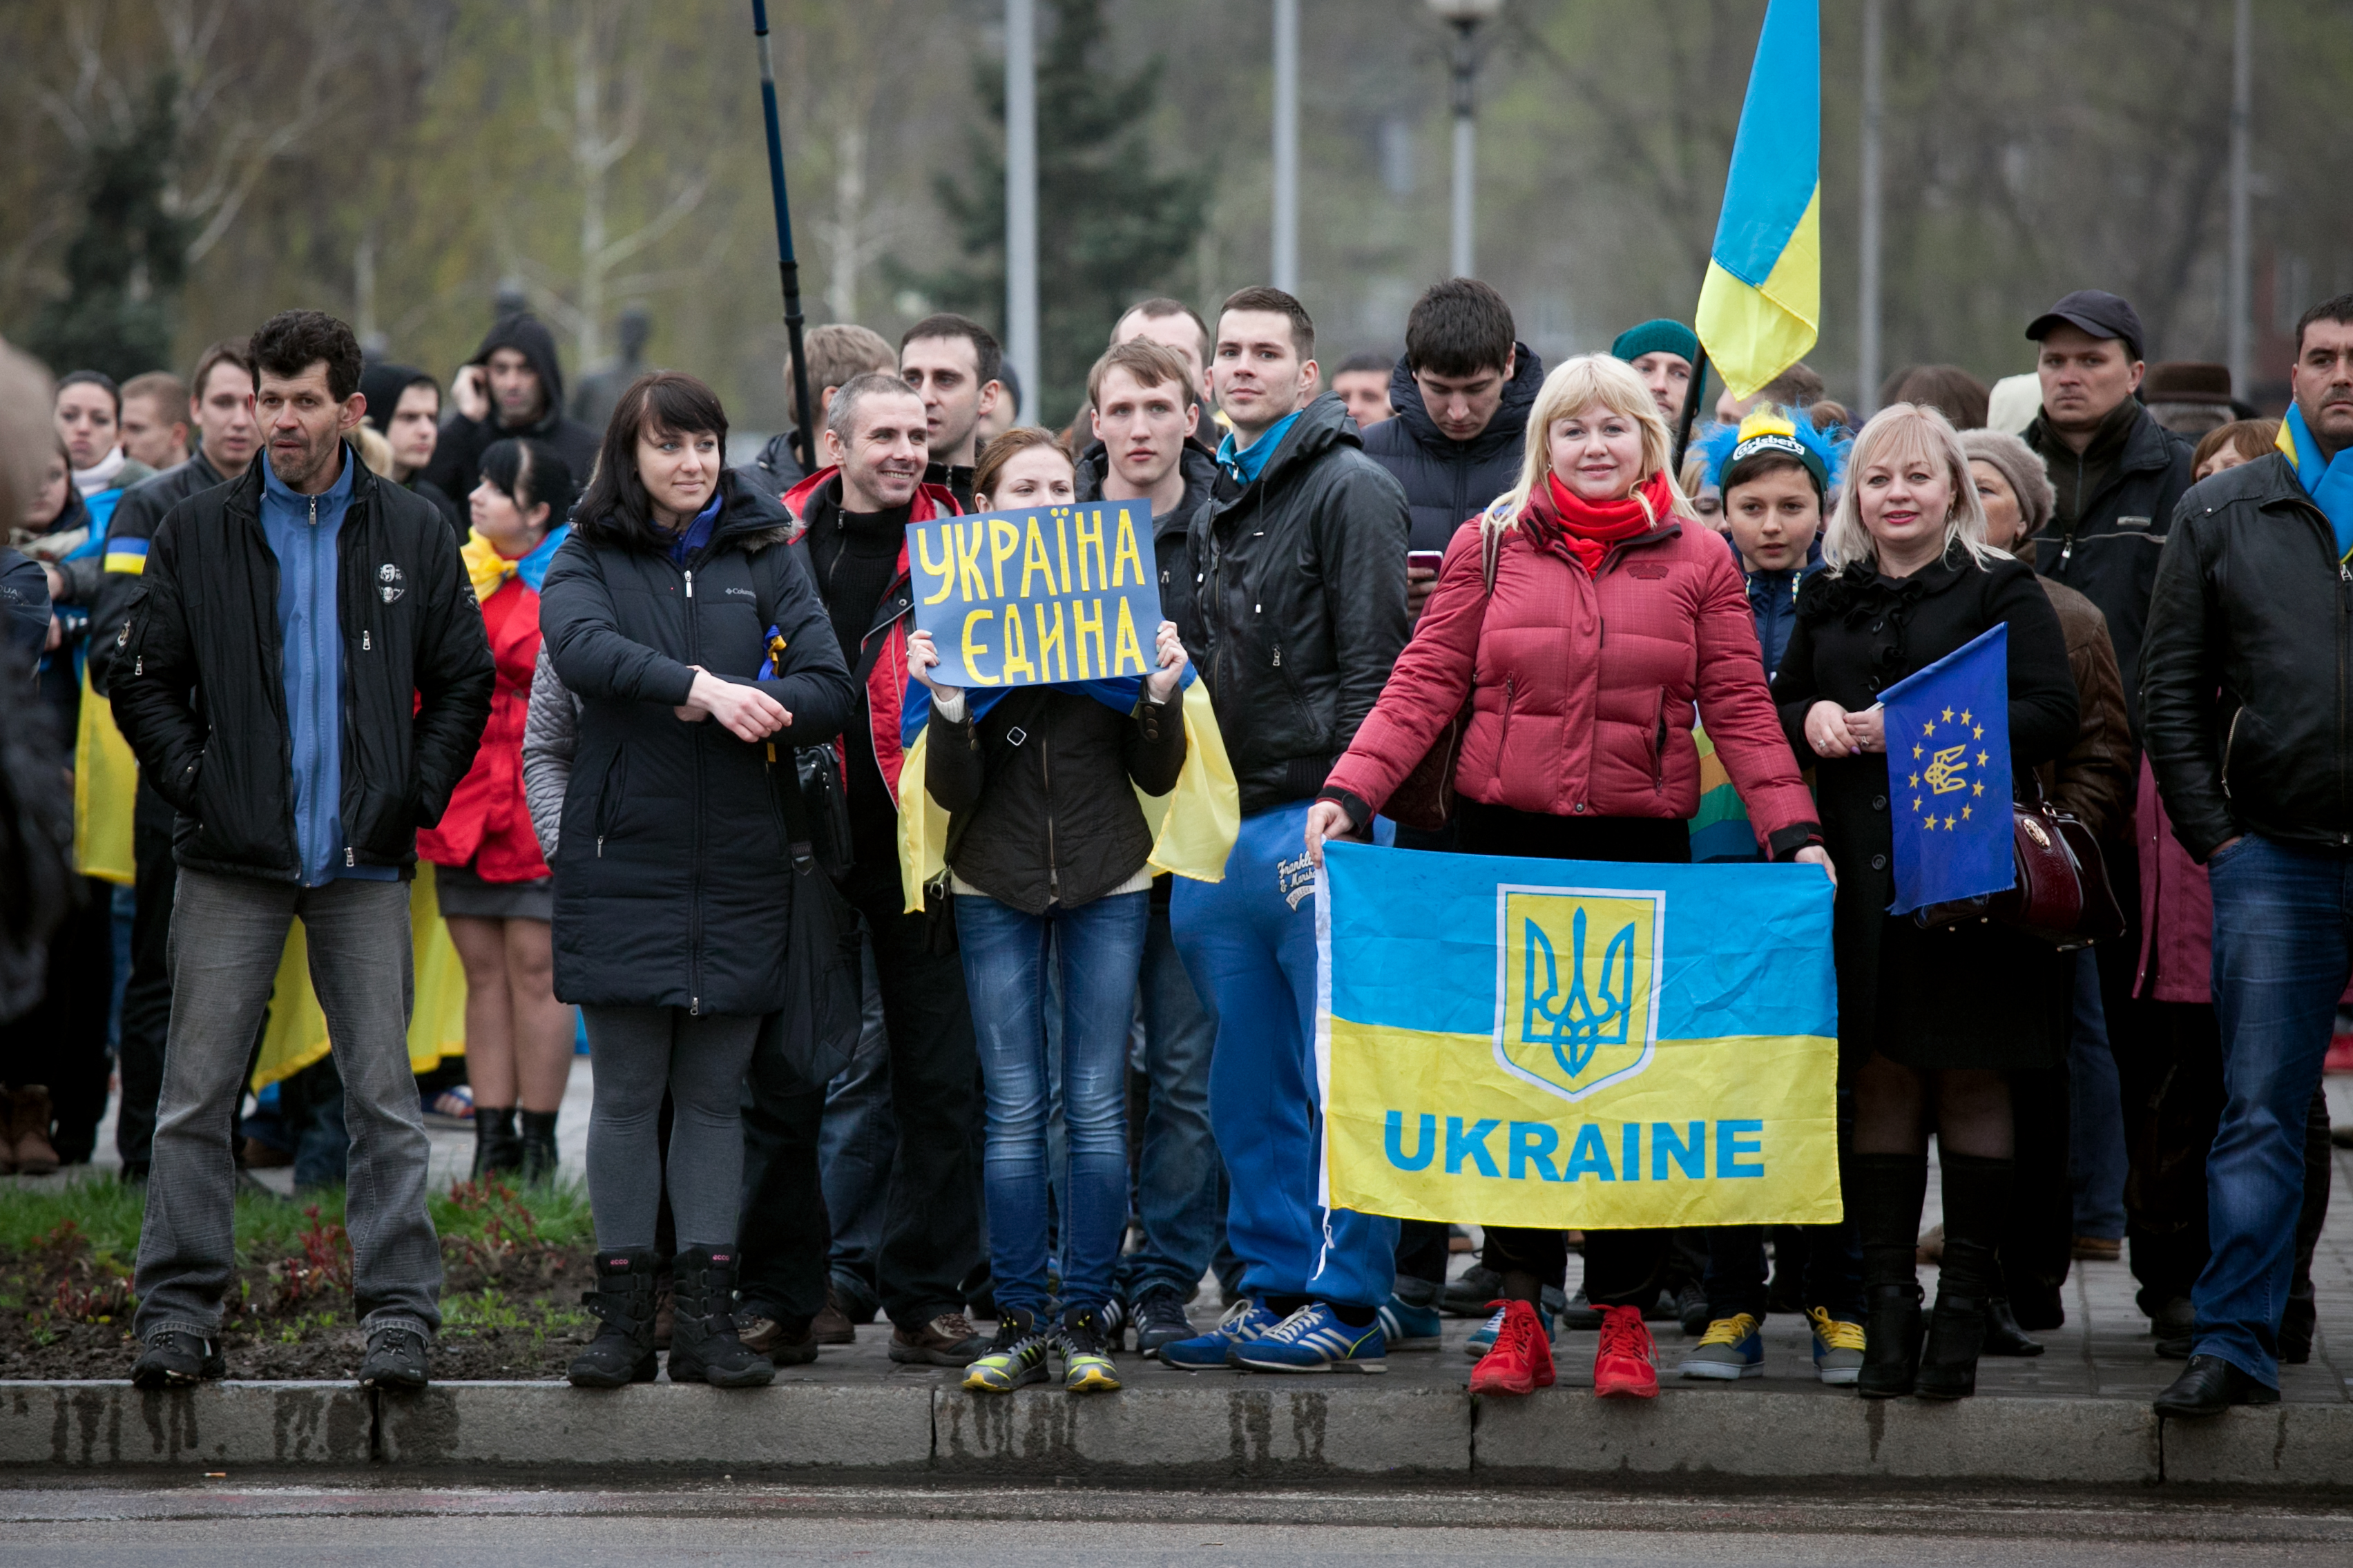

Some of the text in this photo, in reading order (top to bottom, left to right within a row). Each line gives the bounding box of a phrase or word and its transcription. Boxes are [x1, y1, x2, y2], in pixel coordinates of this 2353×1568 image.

[1733, 434, 1805, 461] Carlsberg
[916, 507, 1146, 605] УКРАЇНА
[961, 596, 1148, 686] ЄДИНА
[1277, 850, 1314, 879] Frankli
[1280, 879, 1287, 893] &
[1289, 887, 1311, 905] COLLEGE
[1384, 1110, 1765, 1182] UKRAINE
